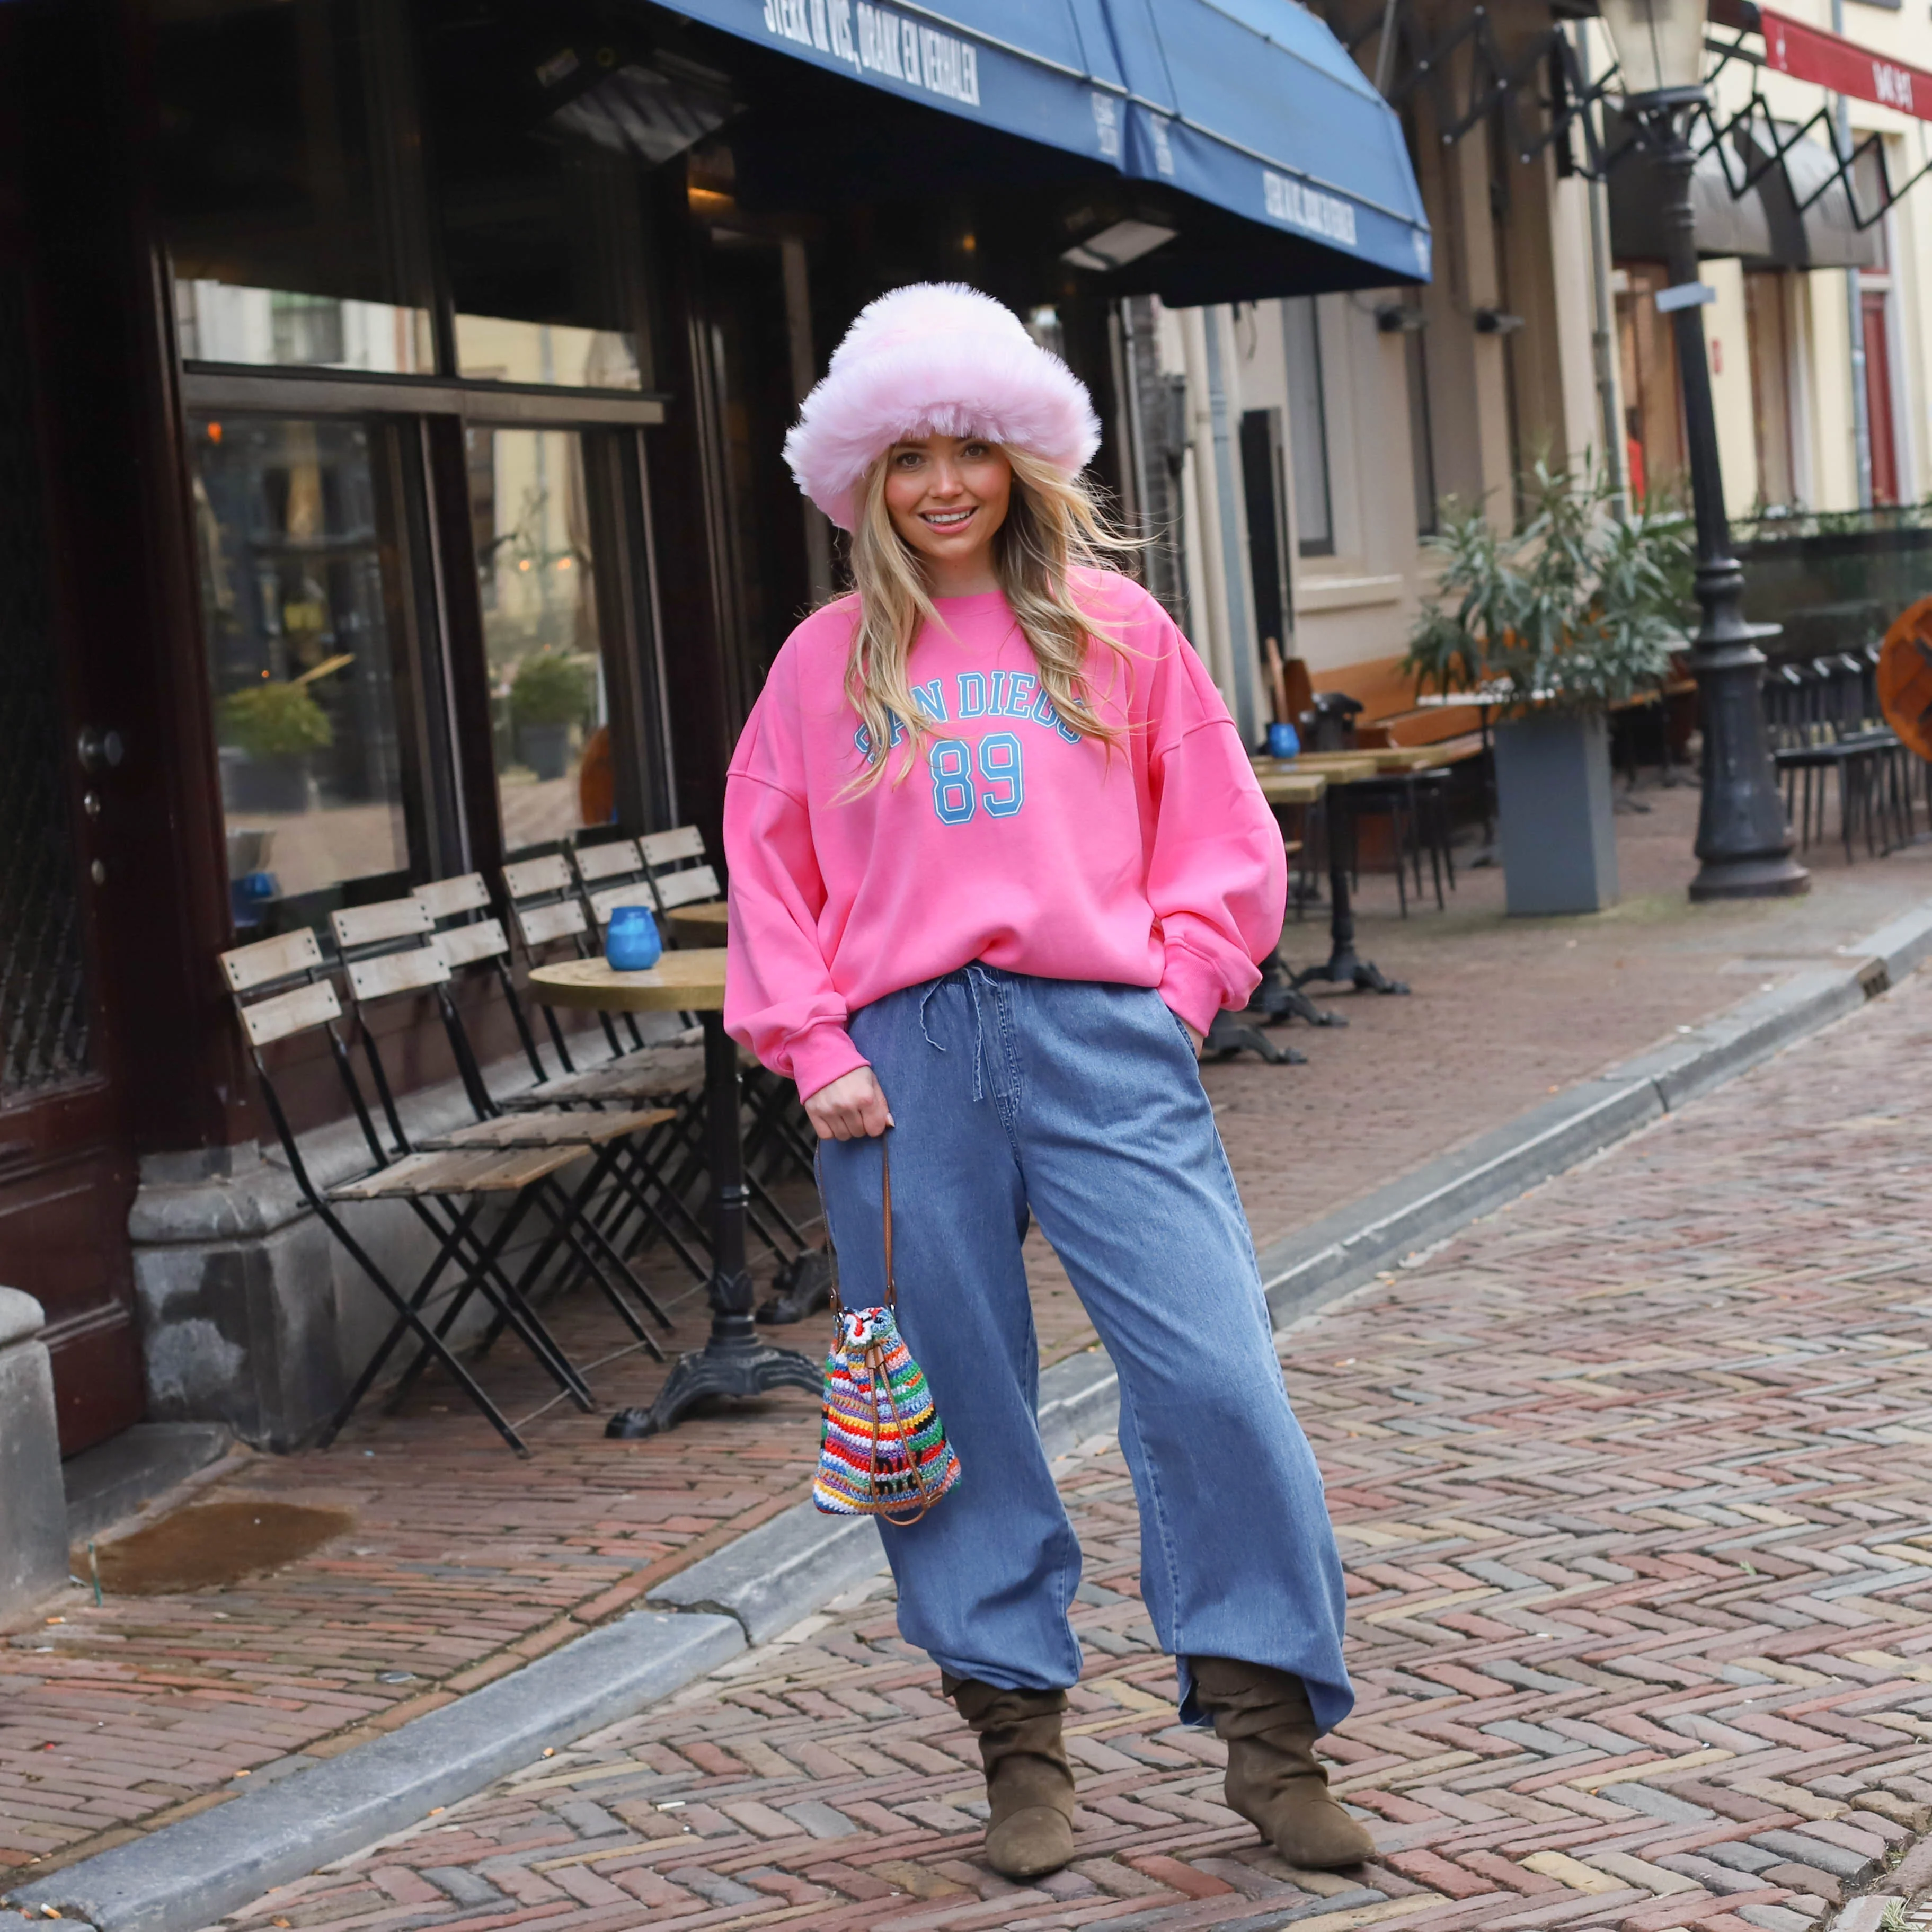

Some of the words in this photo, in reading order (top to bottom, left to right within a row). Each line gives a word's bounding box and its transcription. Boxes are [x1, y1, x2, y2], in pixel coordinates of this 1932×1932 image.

[901, 18, 922, 86] EN
[918, 25, 980, 106] VERHALEN
[929, 730, 1025, 827] 89
